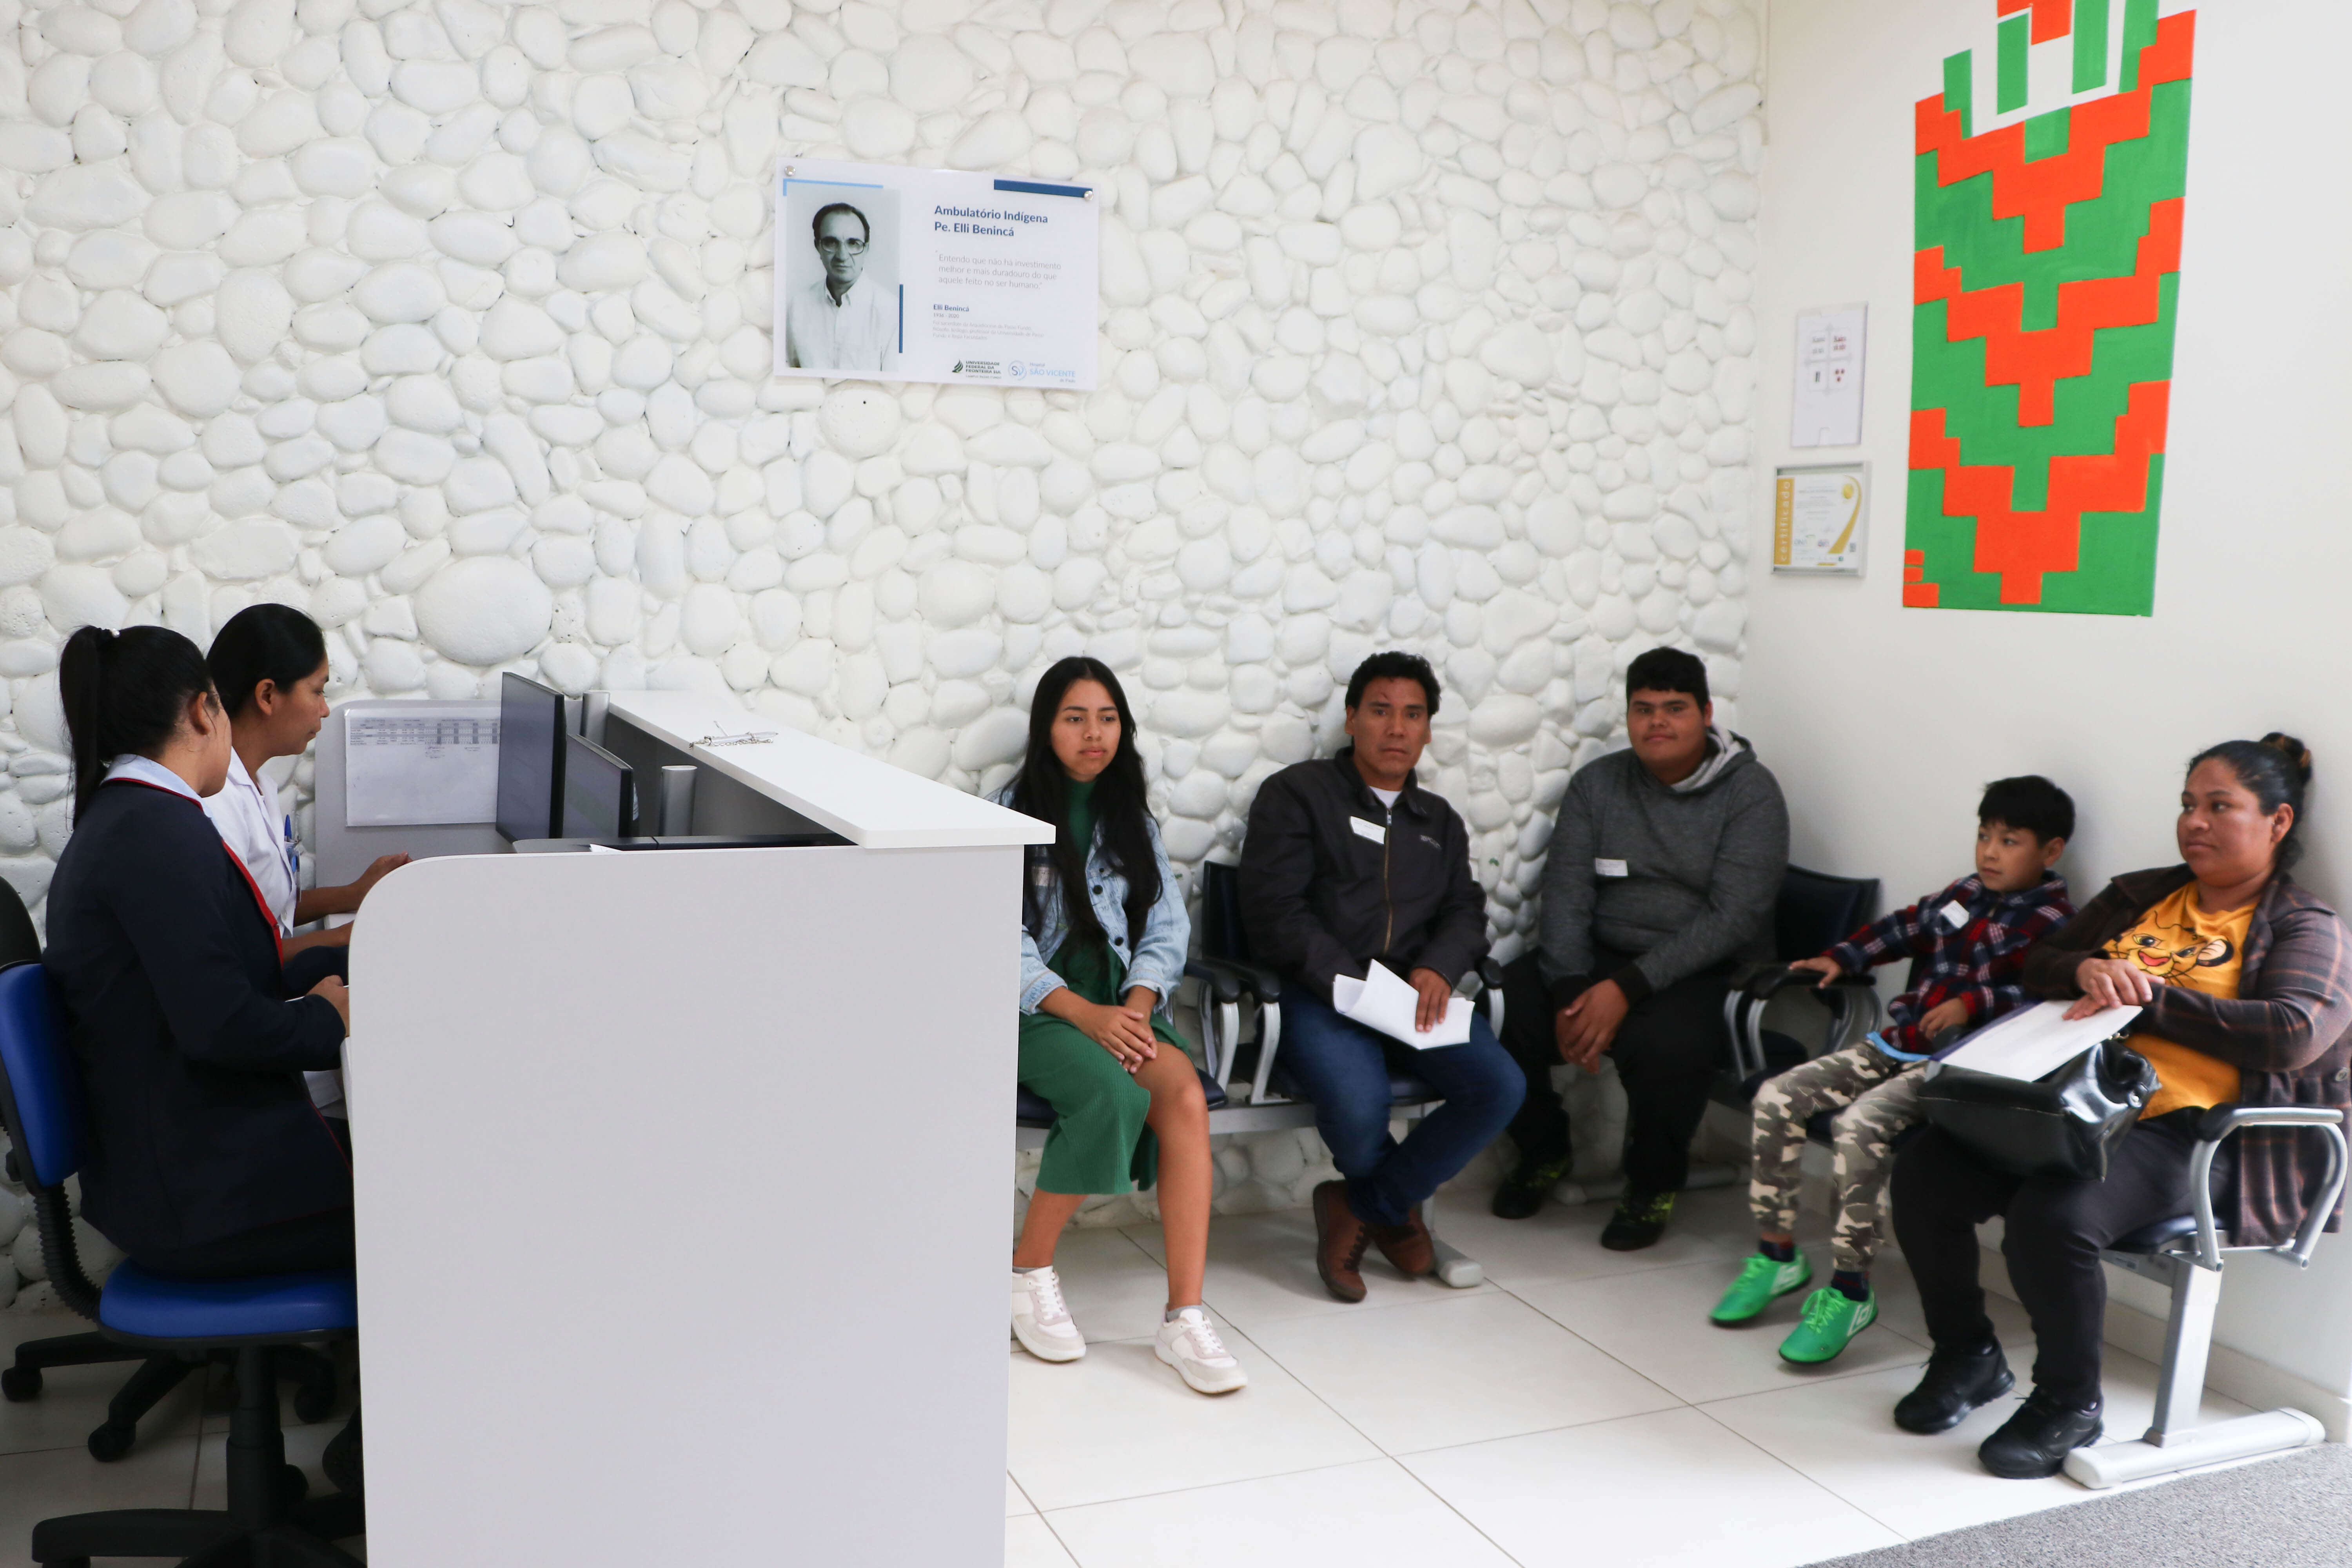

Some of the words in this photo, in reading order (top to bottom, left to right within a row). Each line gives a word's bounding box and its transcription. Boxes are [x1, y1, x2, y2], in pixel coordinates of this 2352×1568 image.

[935, 205, 1001, 219] Ambulatório
[1004, 211, 1047, 223] Indígena
[935, 221, 950, 231] Pe.
[954, 223, 969, 233] Elli
[973, 224, 1014, 236] Benincá
[1015, 260, 1061, 270] investimento
[992, 269, 1029, 278] duradouro
[938, 276, 963, 284] aquele
